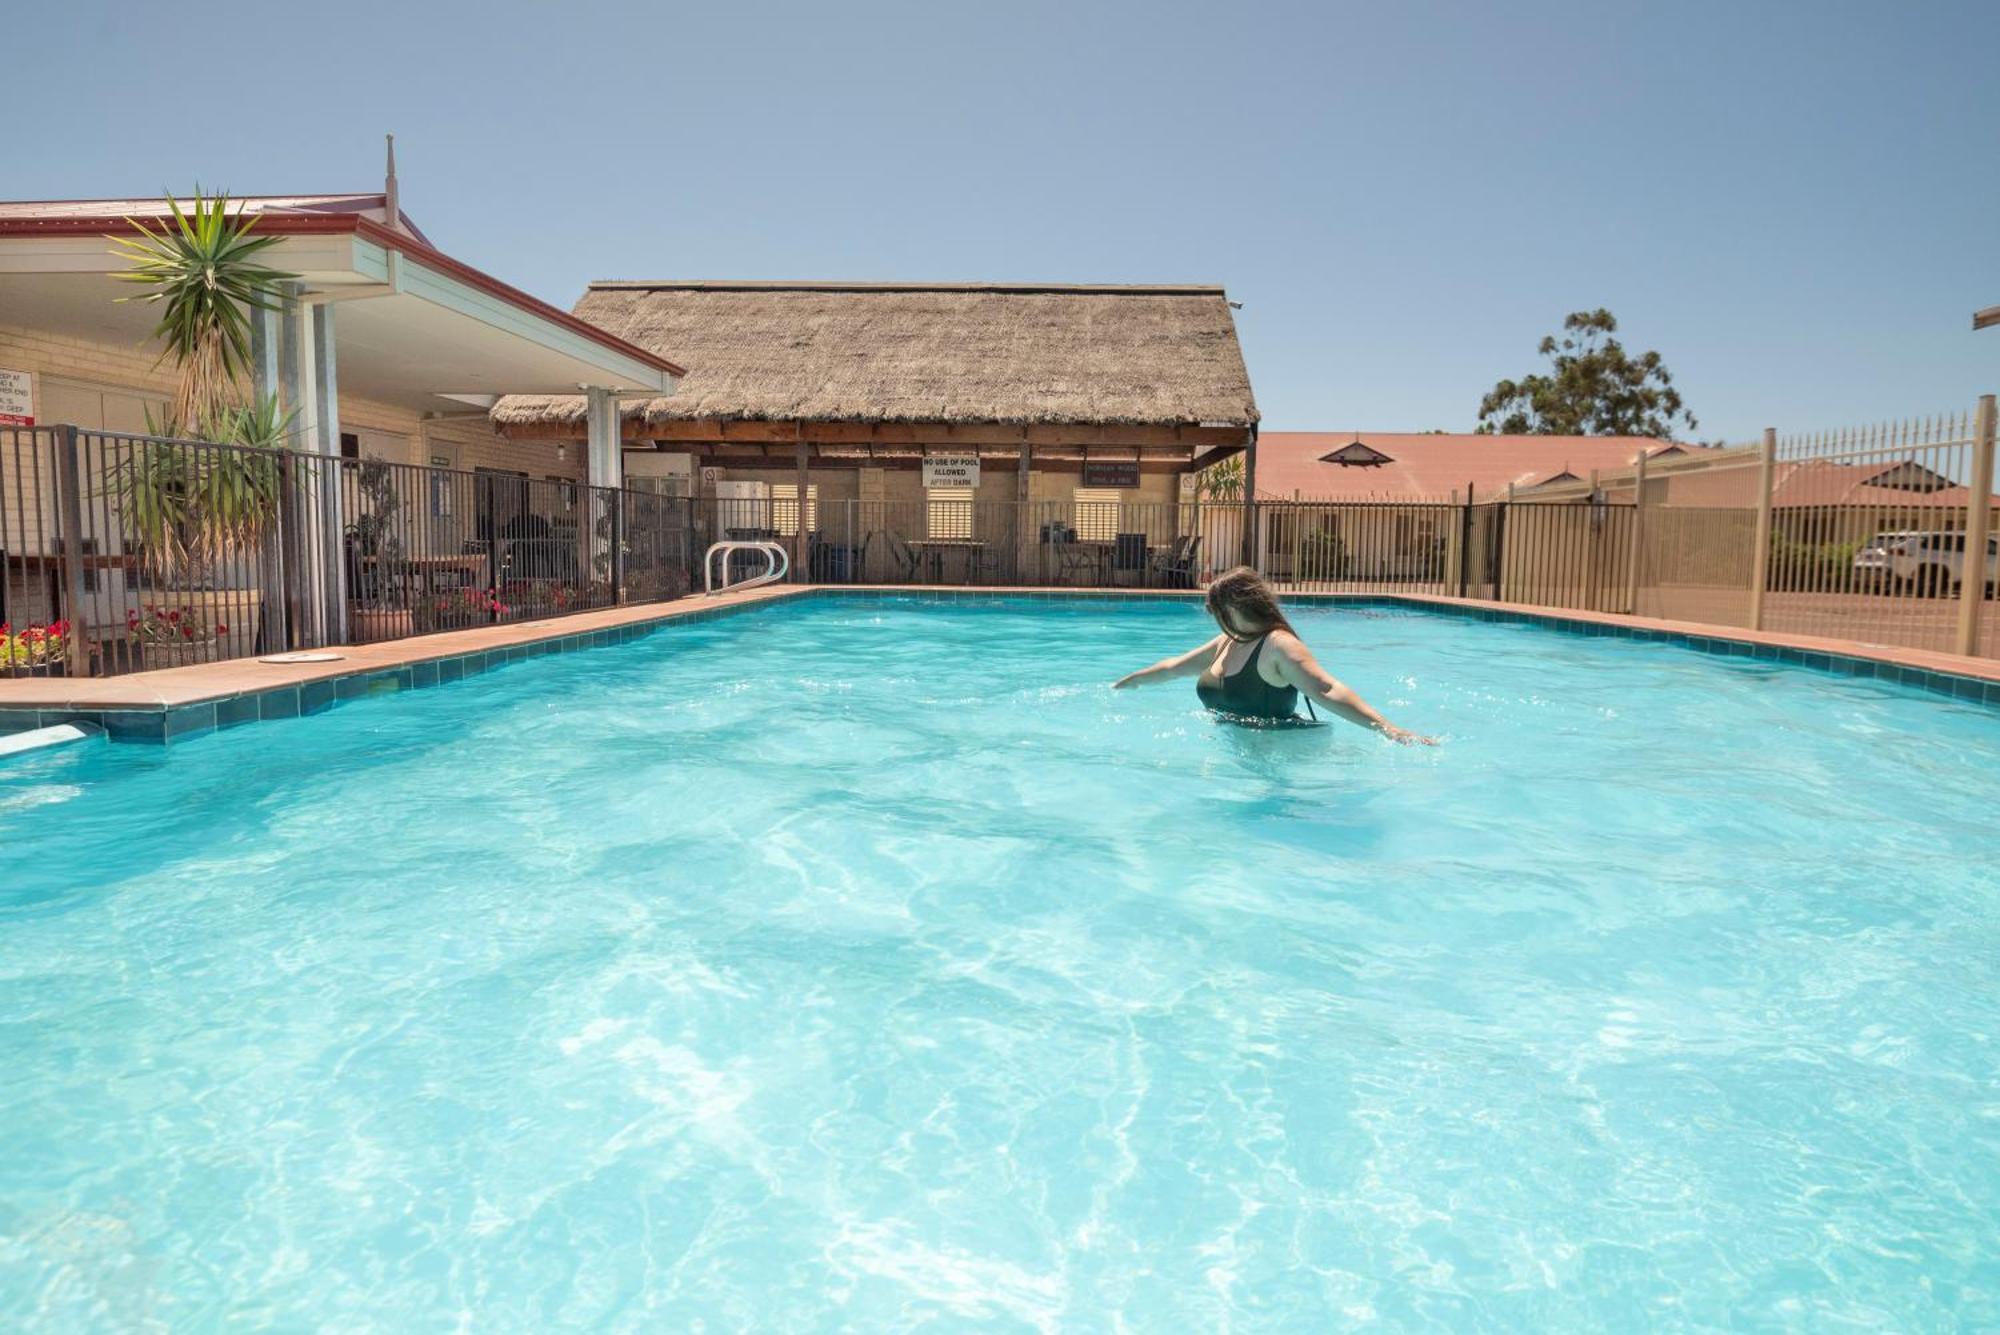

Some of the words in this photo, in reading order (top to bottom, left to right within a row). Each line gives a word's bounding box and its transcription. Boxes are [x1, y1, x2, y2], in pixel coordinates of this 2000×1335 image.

[924, 458, 933, 466] NO
[935, 458, 948, 466] USE
[960, 458, 979, 466] POOL
